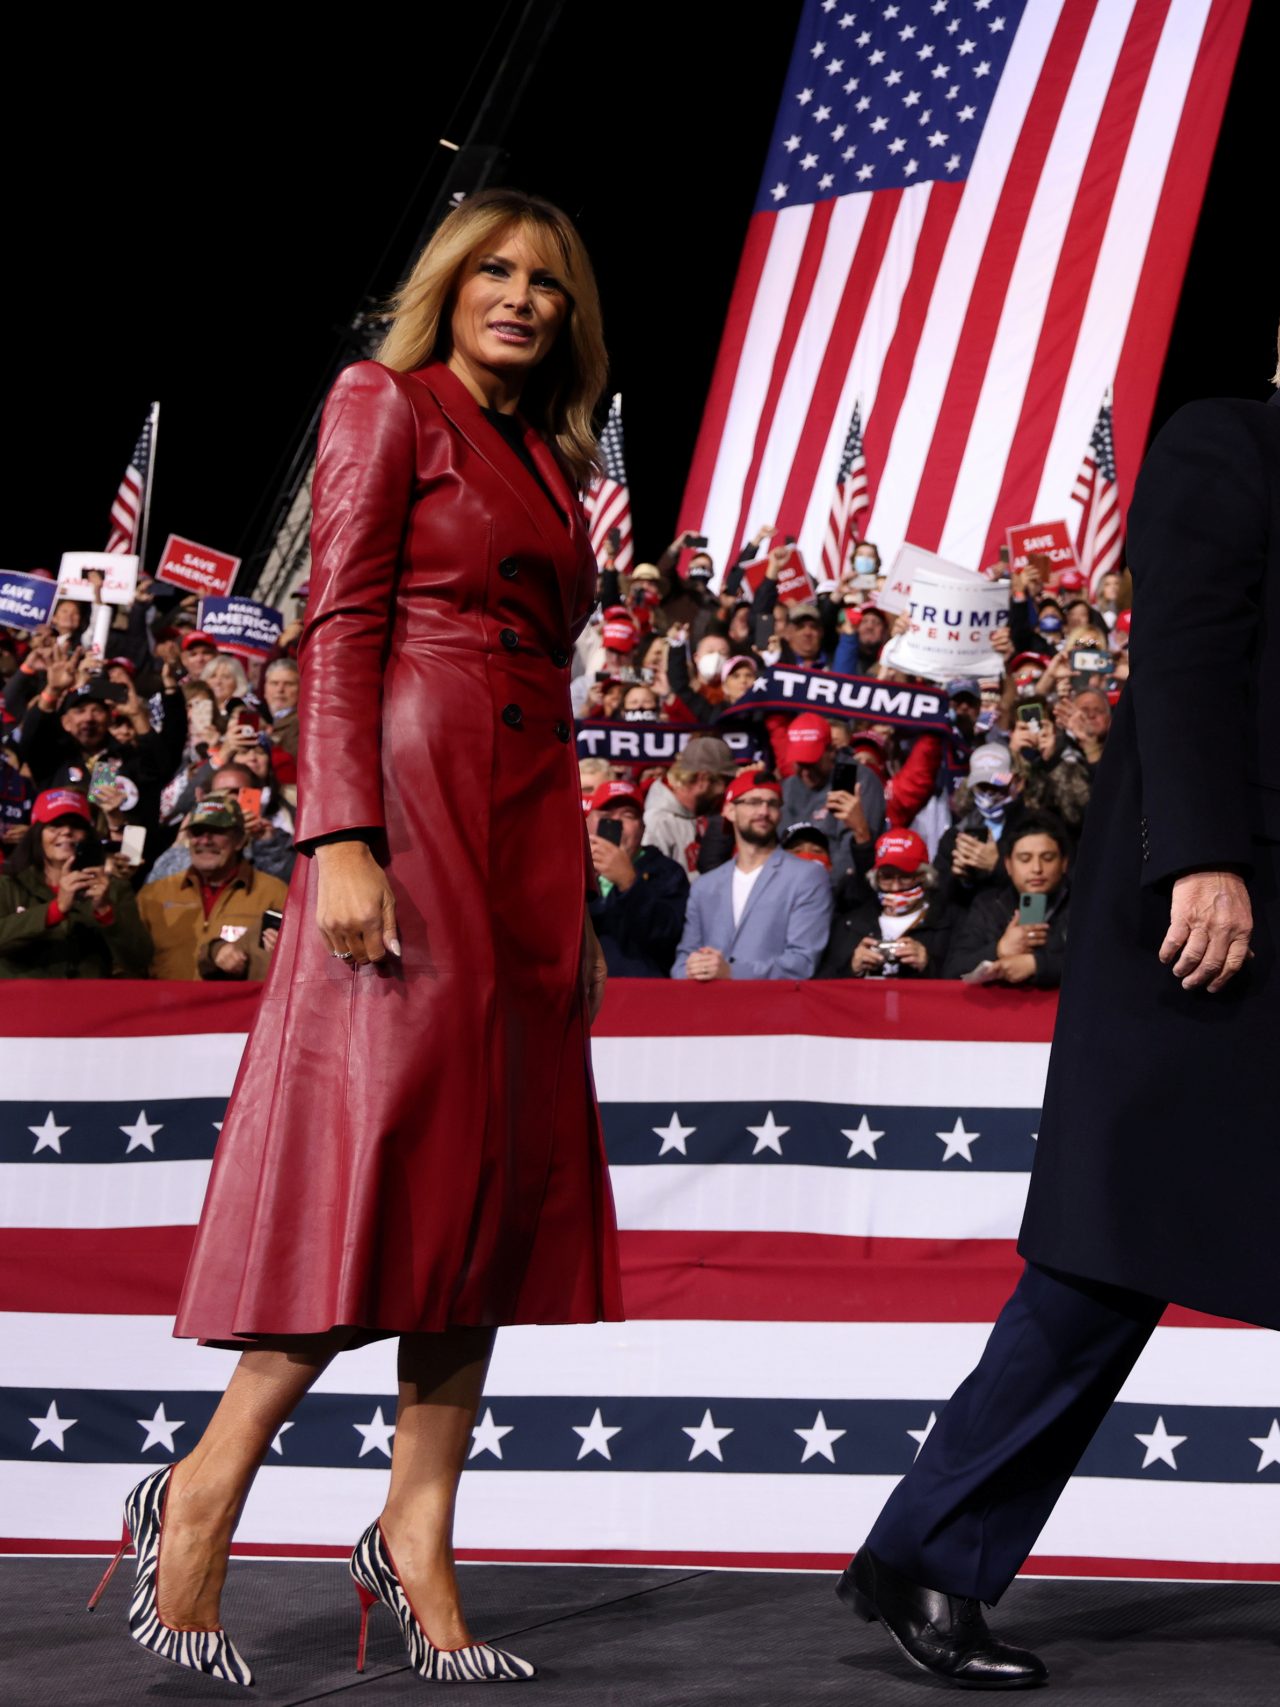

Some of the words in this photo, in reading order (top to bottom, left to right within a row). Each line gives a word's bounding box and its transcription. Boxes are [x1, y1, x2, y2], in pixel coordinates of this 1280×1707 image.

[1023, 534, 1054, 552] SAVE
[183, 552, 217, 574] SAVE
[163, 560, 227, 591] AMERICA!
[1, 583, 35, 602] SAVE
[227, 603, 262, 618] MAKE
[908, 602, 1009, 627] TRUMP
[202, 624, 244, 637] GREAT
[203, 612, 281, 633] AMERICA
[773, 670, 940, 718] TRUMP
[577, 729, 749, 758] TRUP
